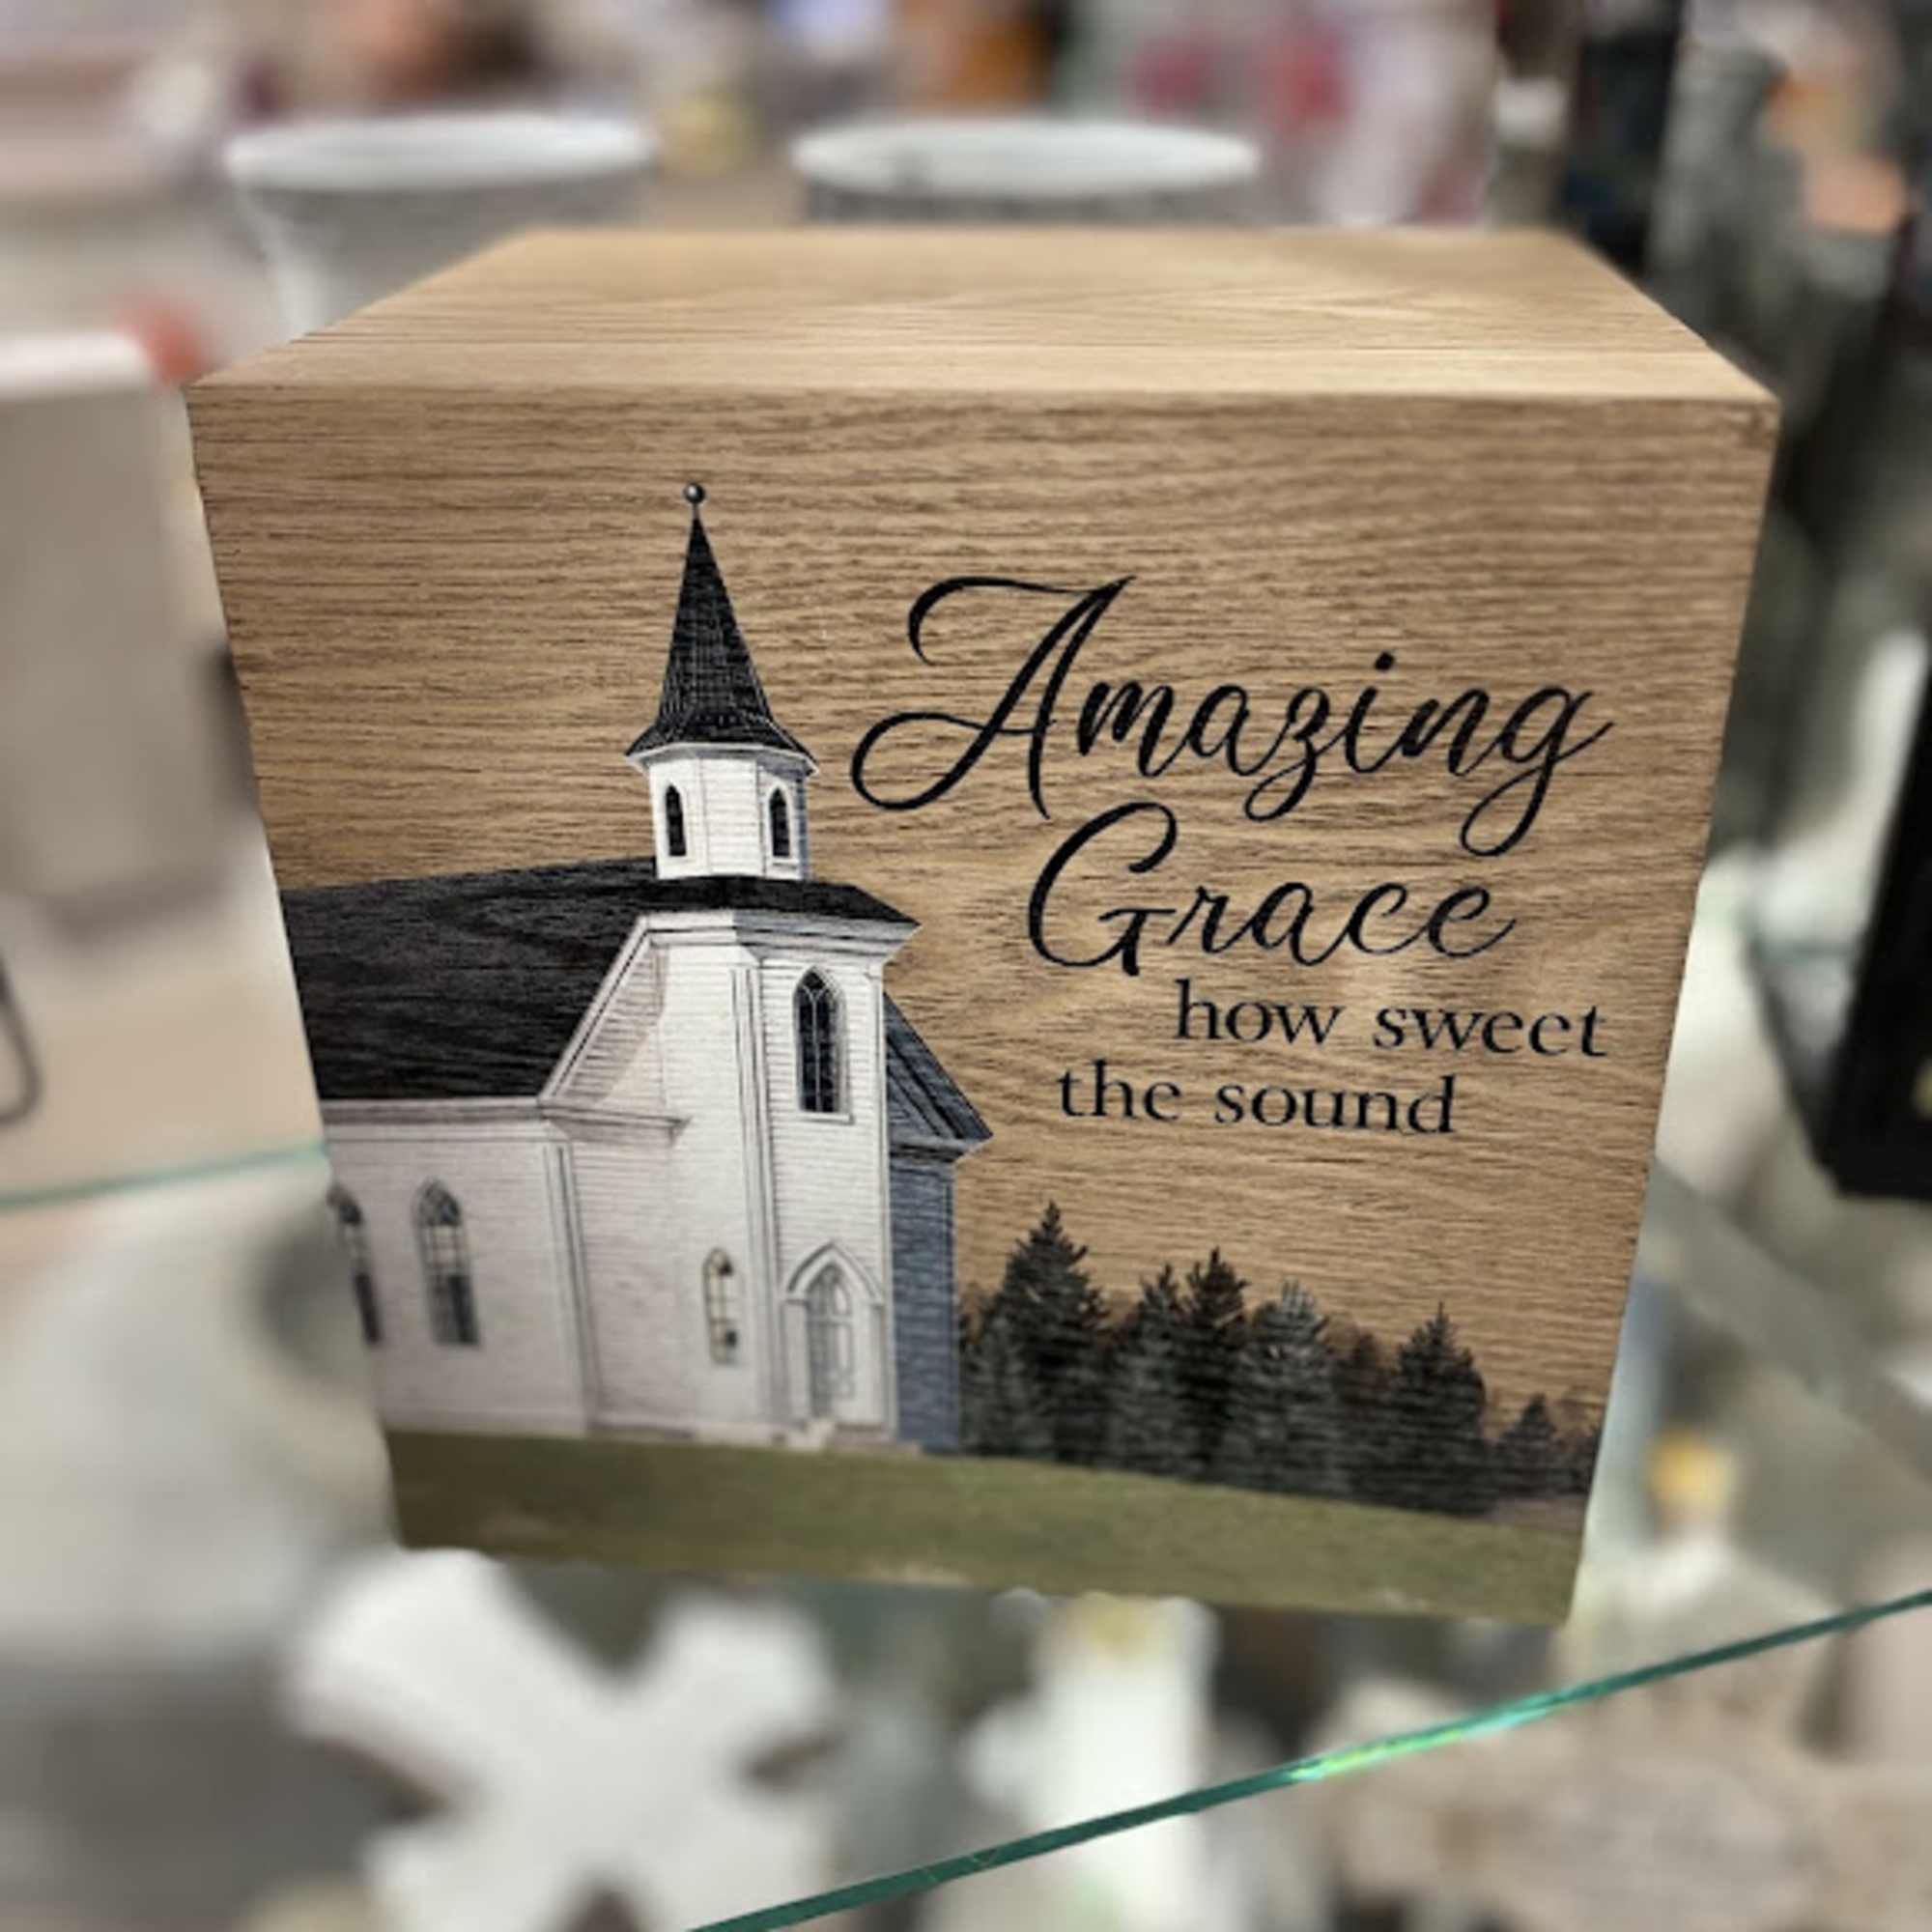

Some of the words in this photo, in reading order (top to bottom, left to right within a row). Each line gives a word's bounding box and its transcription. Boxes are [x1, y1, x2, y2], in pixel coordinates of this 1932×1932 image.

[850, 575, 1615, 858] Amazing
[1026, 802, 1519, 977] Grace
[1175, 978, 1343, 1046] how
[1374, 1002, 1608, 1059] sweet
[1057, 1057, 1183, 1122] the
[1214, 1073, 1457, 1137] sound
